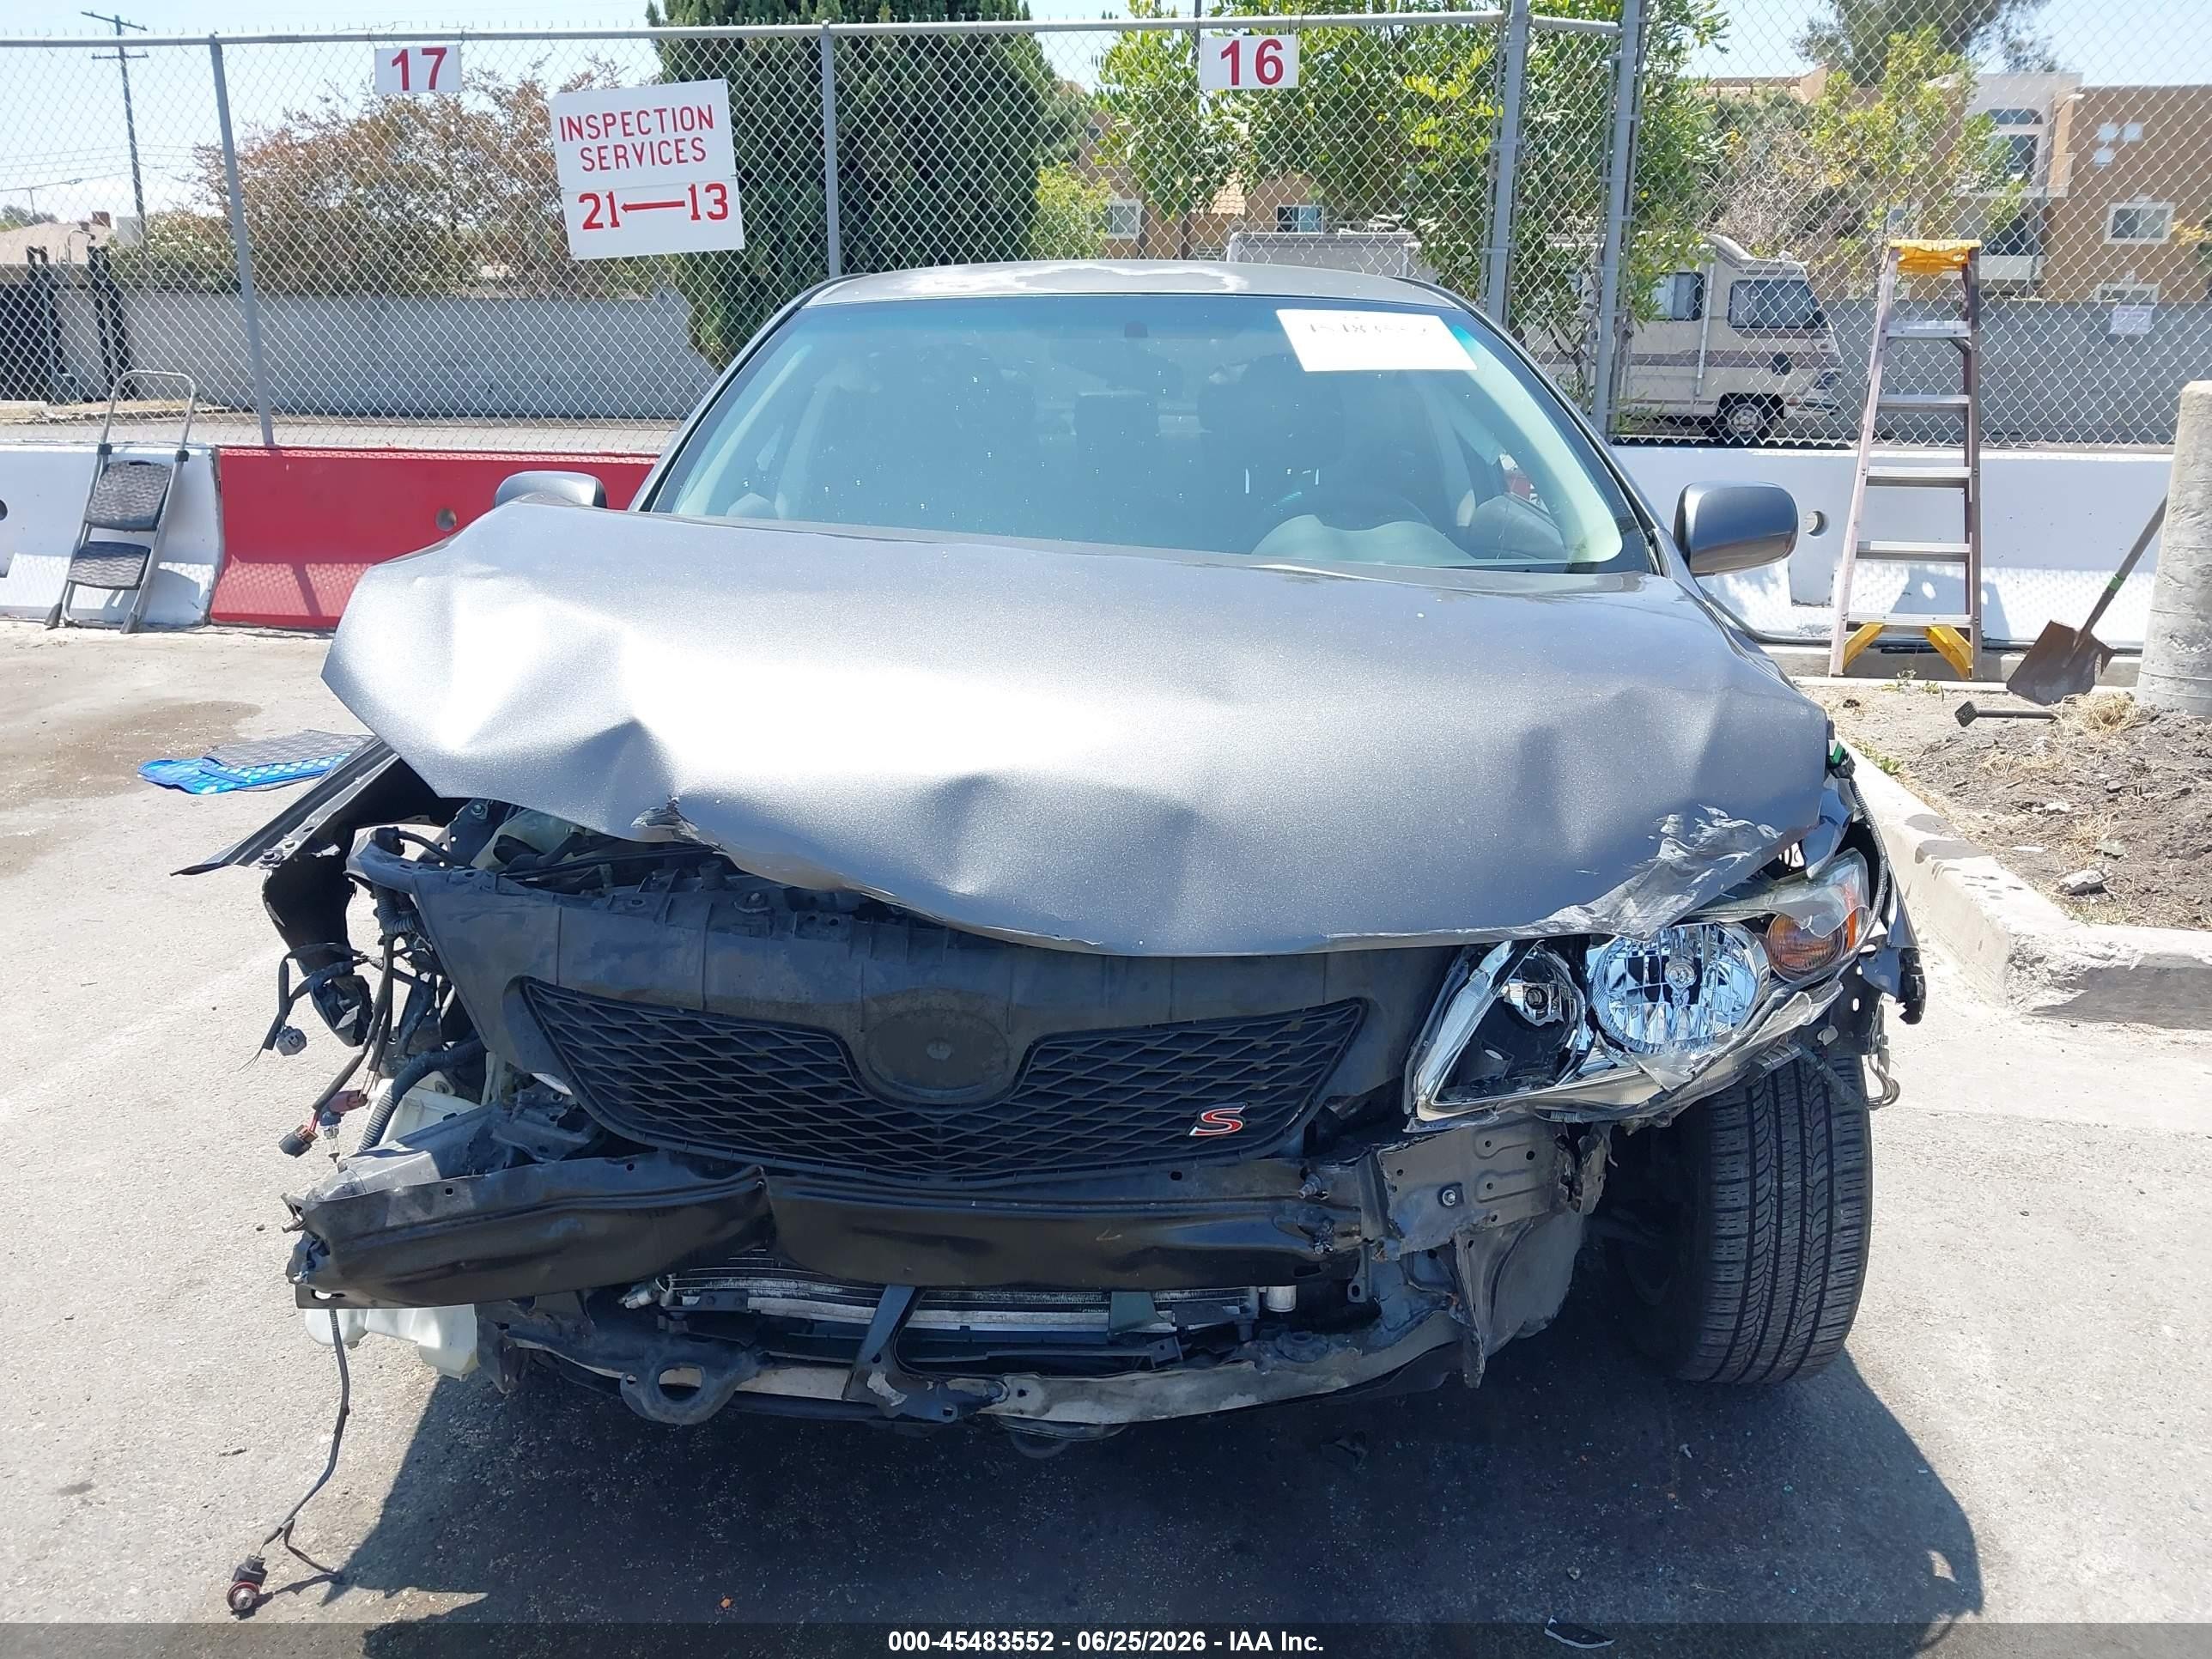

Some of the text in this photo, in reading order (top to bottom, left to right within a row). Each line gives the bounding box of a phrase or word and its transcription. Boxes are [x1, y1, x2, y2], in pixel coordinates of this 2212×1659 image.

[391, 46, 447, 92] 17
[1220, 38, 1285, 86] 16
[559, 104, 714, 142] INSPECTION
[580, 137, 707, 173] SERVICES
[578, 181, 729, 230] 21 13
[1188, 1103, 1247, 1137] S
